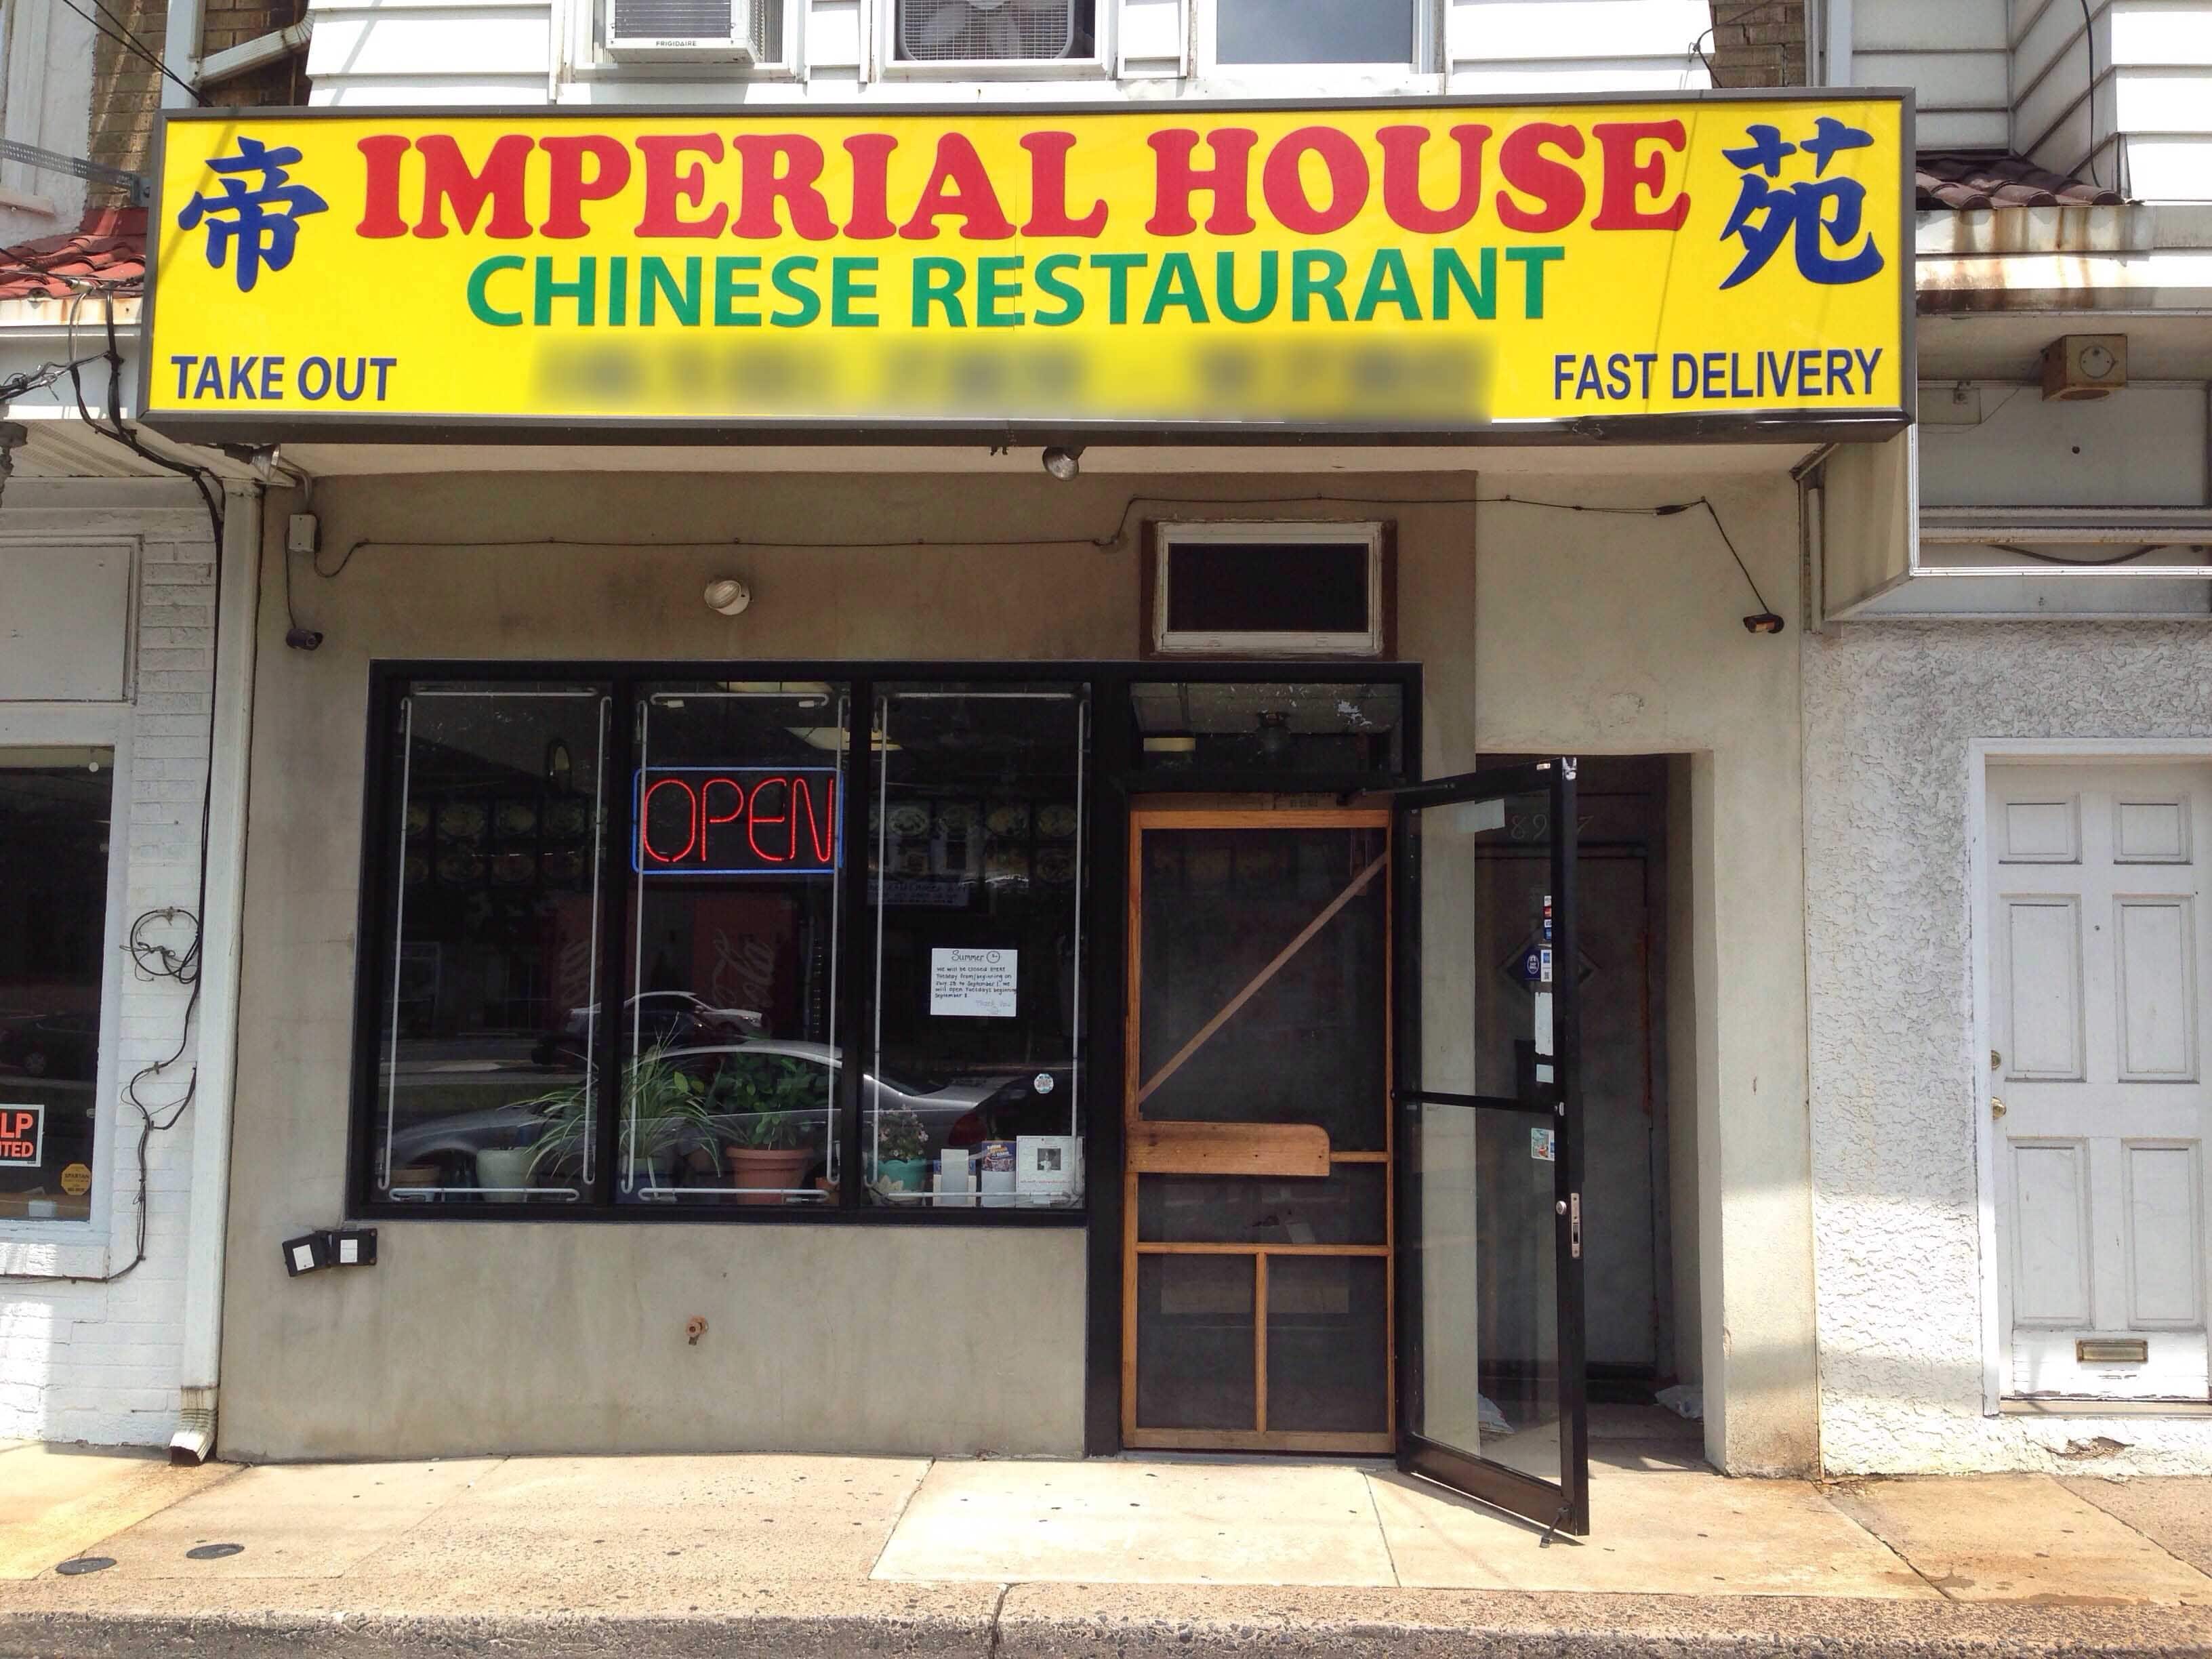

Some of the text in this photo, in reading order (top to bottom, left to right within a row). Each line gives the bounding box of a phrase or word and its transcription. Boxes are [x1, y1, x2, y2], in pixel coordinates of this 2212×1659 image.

[178, 136, 329, 292] 帝
[356, 119, 1691, 241] IMPERIAL HOUSE
[1719, 117, 1884, 290] 苑
[467, 246, 1565, 328] CHINESE RESTAURANT
[171, 356, 397, 401] TAKE OUT
[1555, 348, 1883, 400] FAST DELIVERY
[644, 778, 836, 863] OPEN
[1511, 813, 1594, 841] 897
[951, 949, 984, 962] Summer
